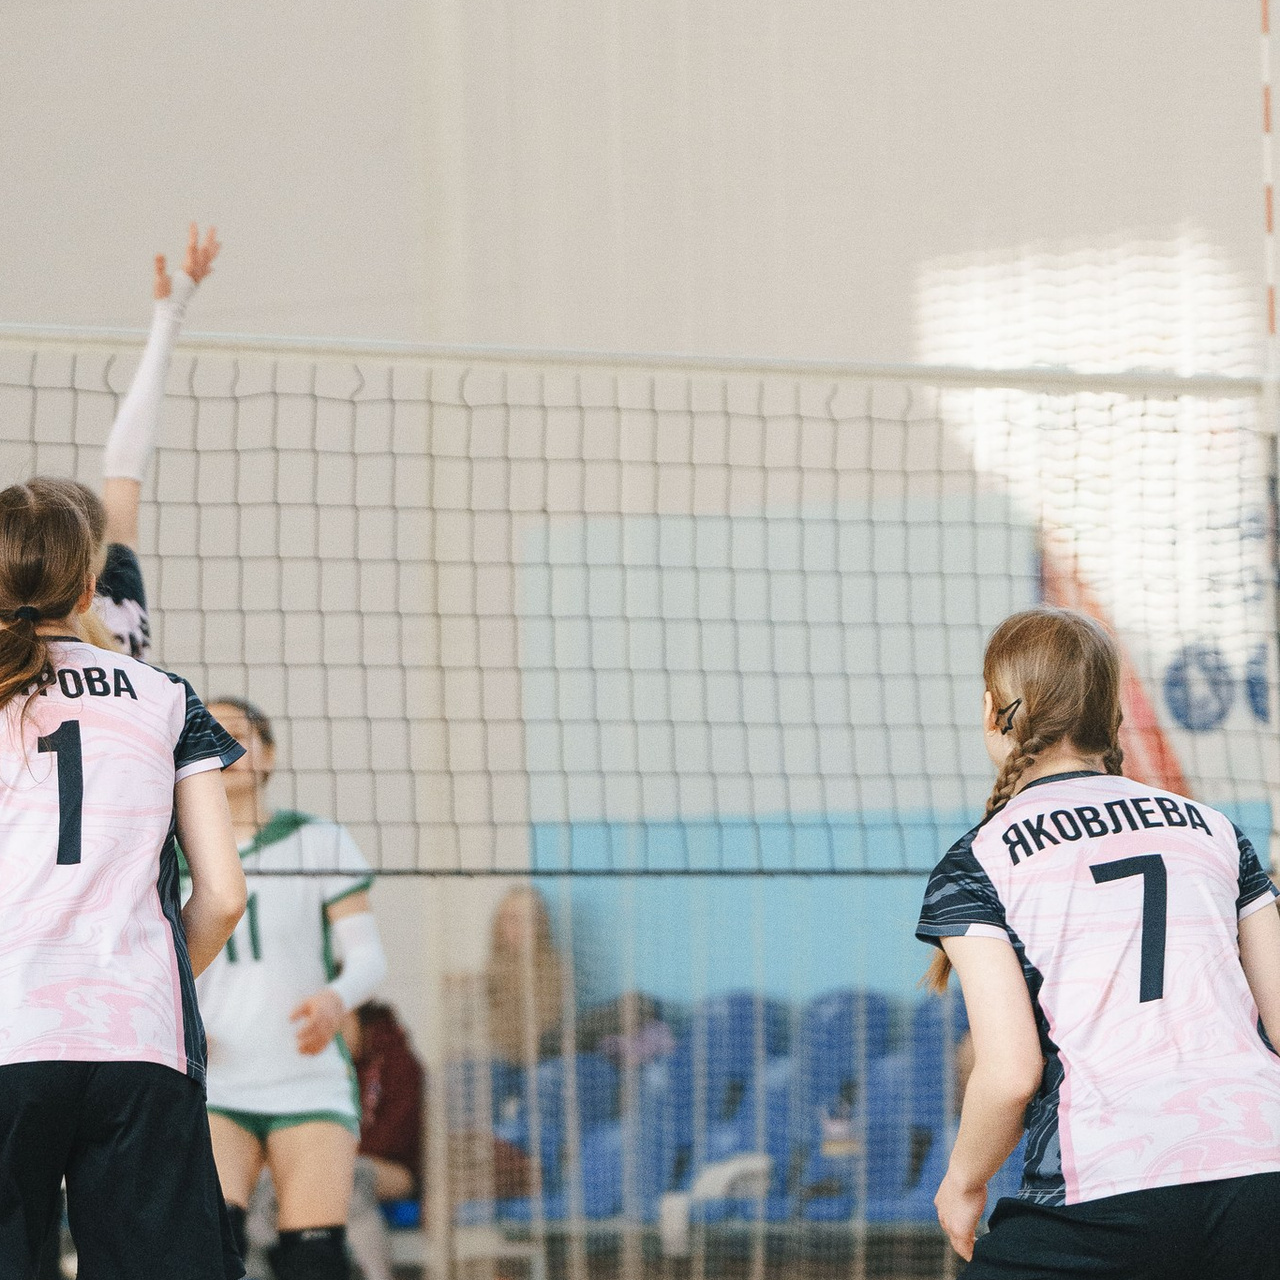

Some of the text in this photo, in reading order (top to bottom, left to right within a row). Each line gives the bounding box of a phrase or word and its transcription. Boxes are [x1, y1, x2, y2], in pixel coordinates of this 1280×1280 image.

[37, 719, 84, 865] 1
[1001, 797, 1213, 866] ЯКОВЛЕВА
[1089, 854, 1167, 1003] 7
